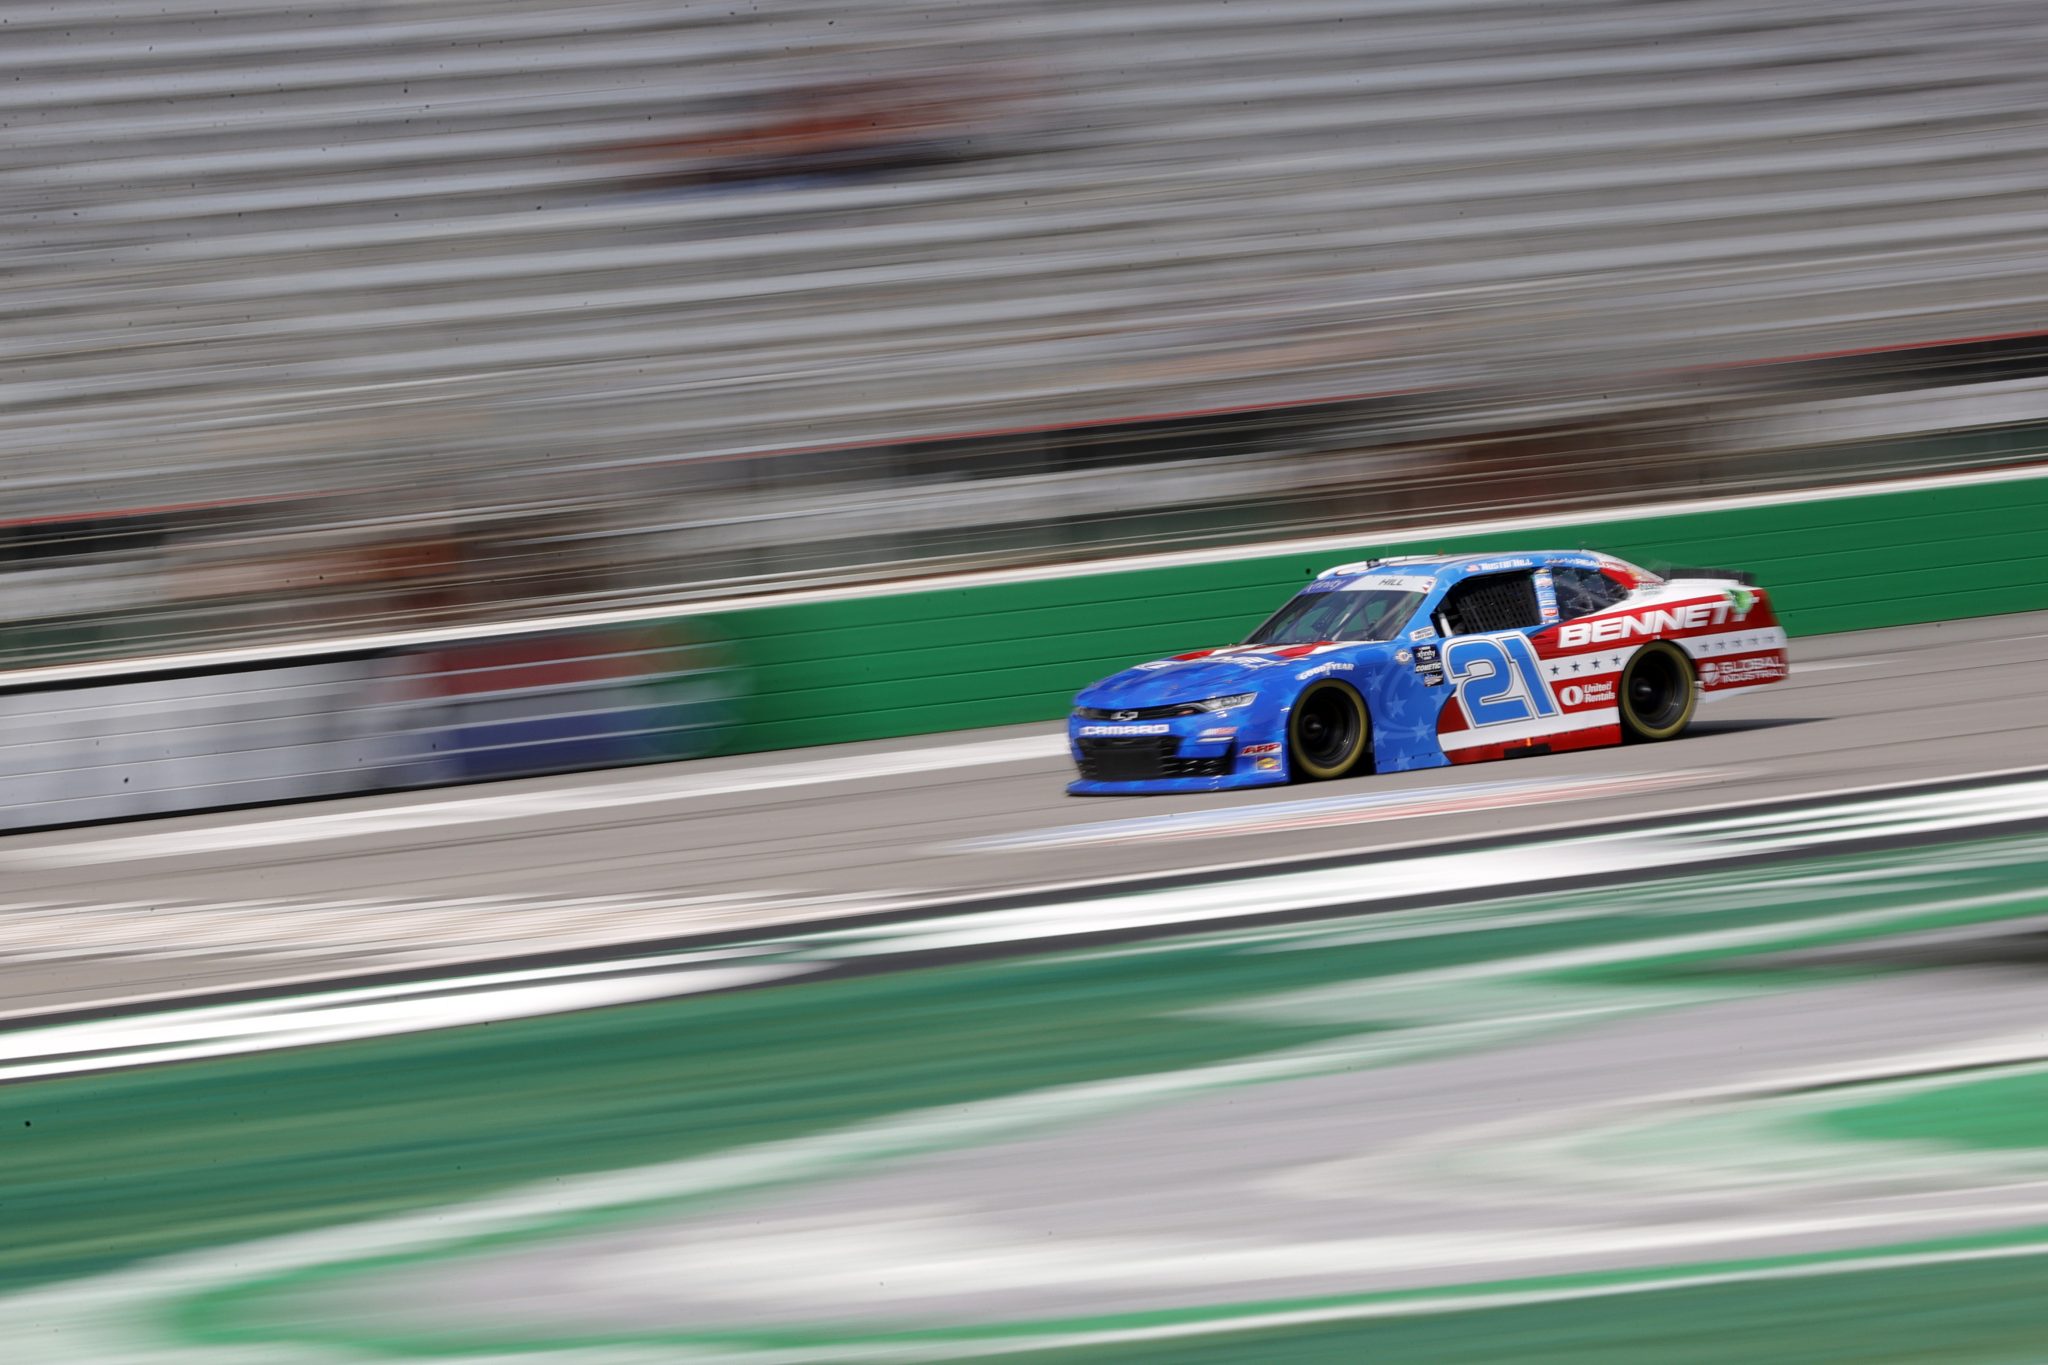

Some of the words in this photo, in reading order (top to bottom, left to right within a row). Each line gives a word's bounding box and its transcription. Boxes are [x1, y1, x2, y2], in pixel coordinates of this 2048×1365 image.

[1296, 662, 1354, 681] GOODYEAR
[1722, 656, 1785, 674] GLOBAL
[1447, 634, 1559, 728] 21
[1721, 668, 1787, 683] INDUSTRIAL
[1582, 681, 1613, 694] United
[1583, 691, 1616, 703] Rentals
[1079, 724, 1169, 736] CAMARO
